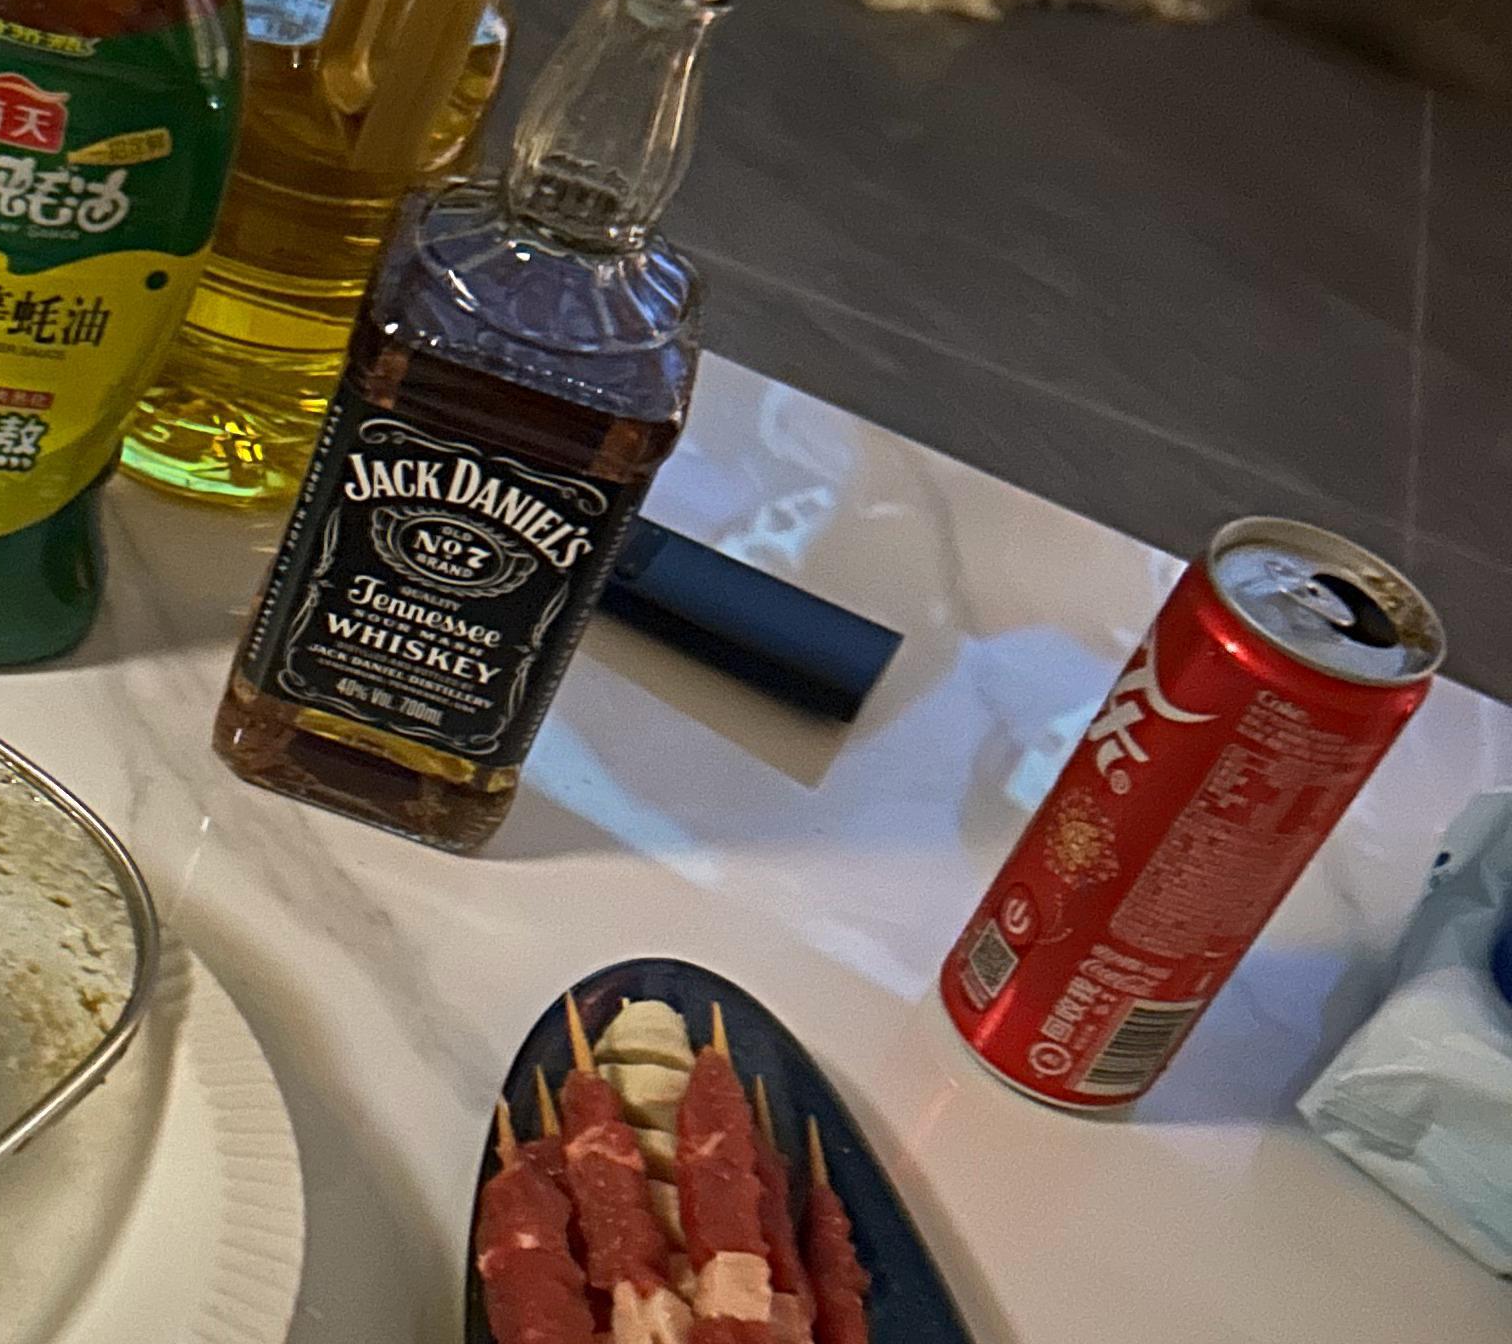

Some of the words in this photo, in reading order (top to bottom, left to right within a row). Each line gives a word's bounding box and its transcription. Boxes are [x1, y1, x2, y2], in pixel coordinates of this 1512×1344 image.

[345, 453, 444, 501] JACK
[446, 458, 593, 568] DANIEL'S
[441, 525, 474, 543] OLD
[414, 554, 474, 579] BRAND
[347, 575, 502, 647] Tennessee
[352, 608, 411, 633] SOUR
[419, 630, 485, 656] MASH
[308, 644, 349, 663] JACK
[351, 655, 406, 683] DANIEL
[328, 612, 502, 684] WHISKEY
[336, 677, 369, 702] 40%
